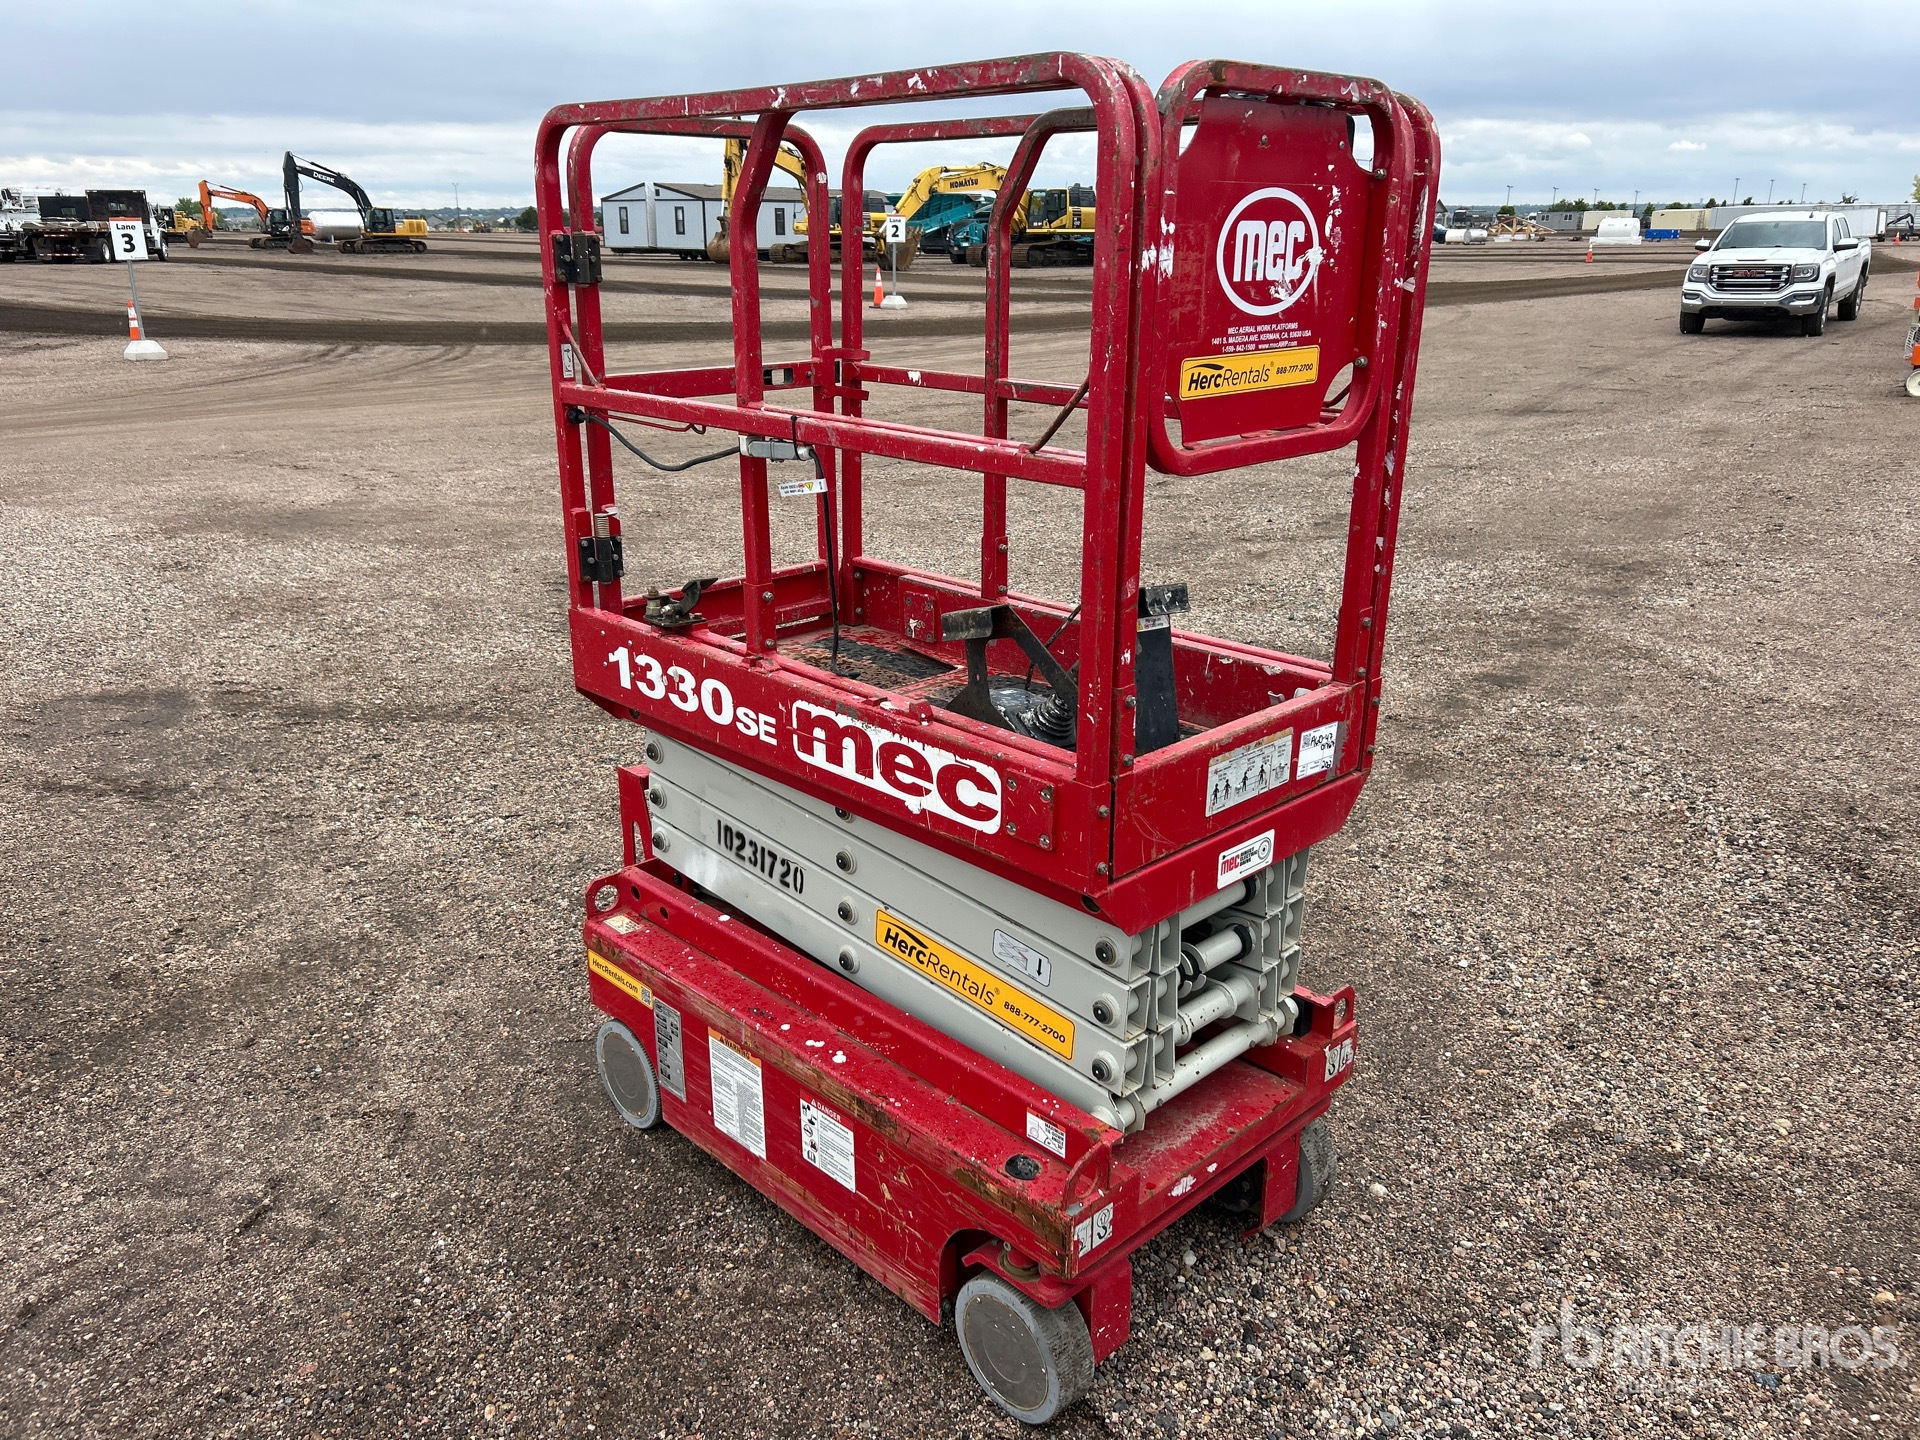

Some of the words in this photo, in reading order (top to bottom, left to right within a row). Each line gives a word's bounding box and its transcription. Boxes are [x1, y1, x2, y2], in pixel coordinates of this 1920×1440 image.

[313, 171, 335, 184] DEERE
[949, 177, 979, 189] KOMATSU
[116, 223, 136, 231] Lane
[891, 224, 900, 238] 2
[121, 232, 136, 253] 3
[1732, 269, 1766, 278] GMC
[1228, 326, 1239, 335] MEC
[1239, 325, 1256, 334] AERIAL
[1257, 323, 1271, 333] WORK
[1271, 322, 1299, 331] PLATFORMS
[1228, 335, 1249, 344] MADERA
[1276, 363, 1314, 375] 888-777-2700
[717, 819, 804, 894] 10231720
[592, 957, 639, 994] HercRentals.com
[1003, 1000, 1067, 1044] 888-777-2700
[817, 1101, 842, 1123] DANGER
